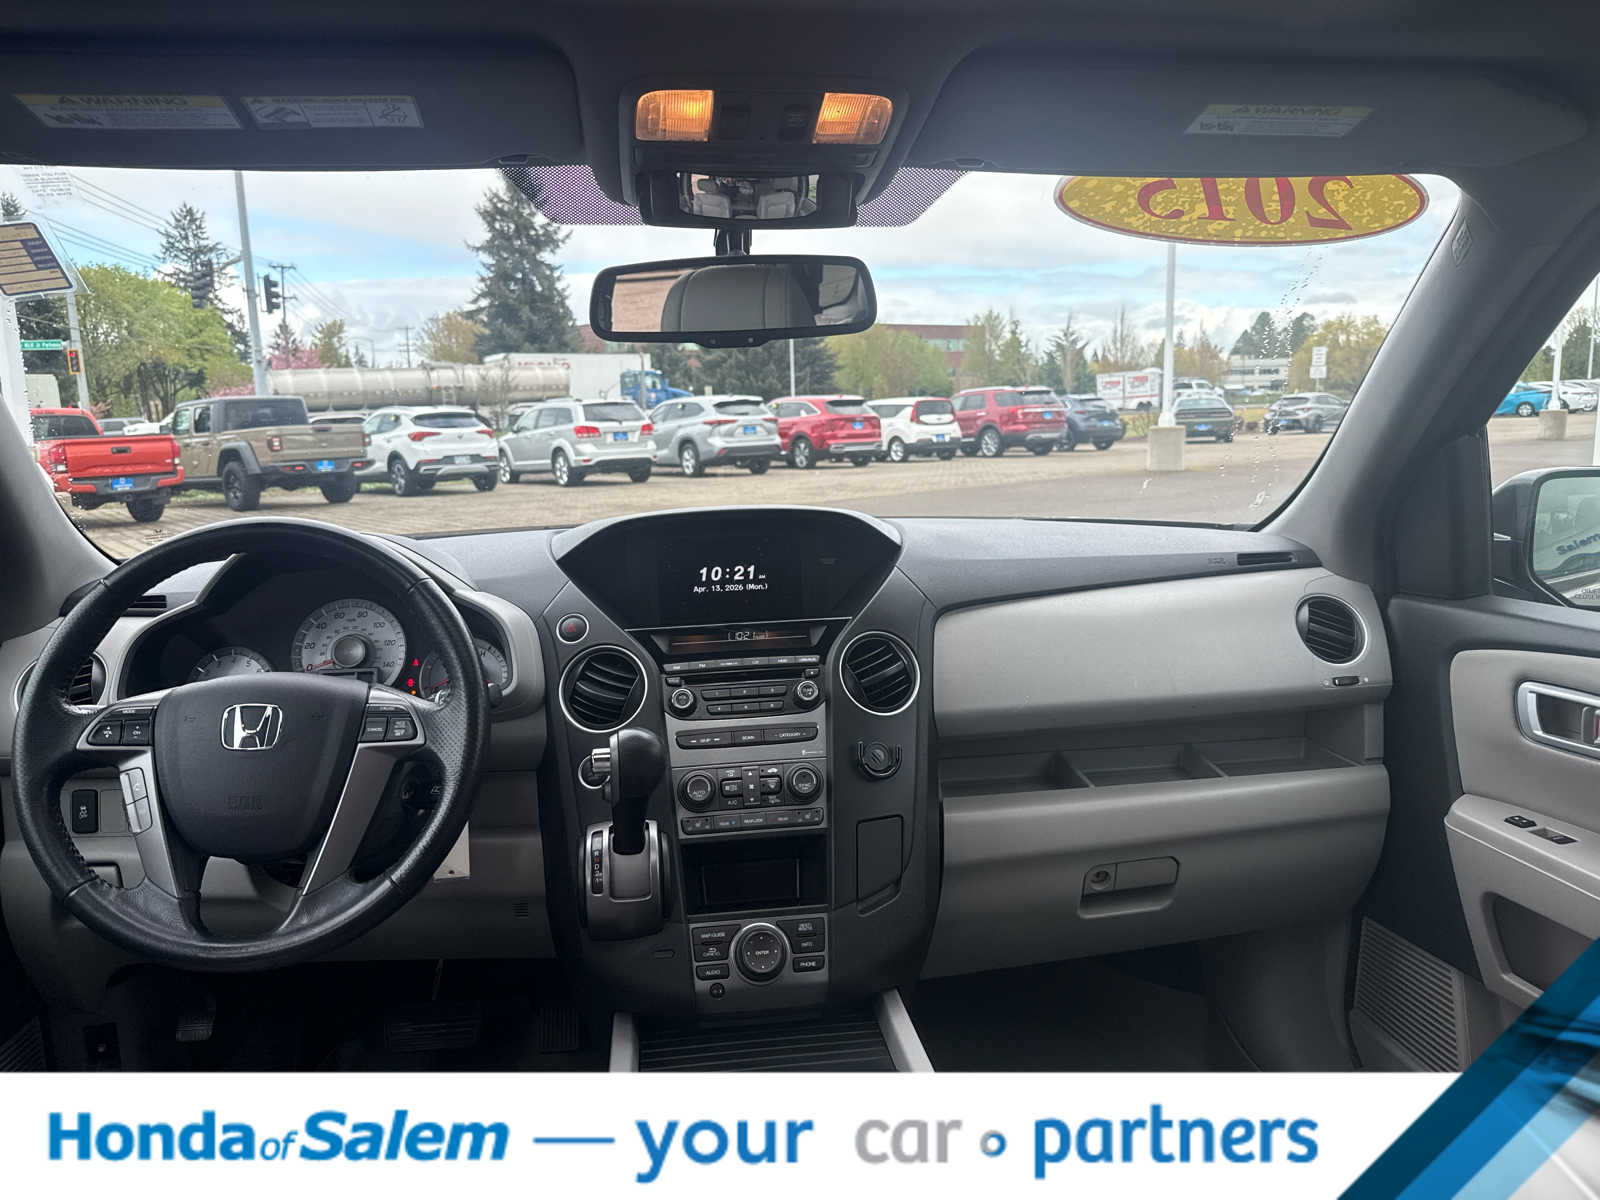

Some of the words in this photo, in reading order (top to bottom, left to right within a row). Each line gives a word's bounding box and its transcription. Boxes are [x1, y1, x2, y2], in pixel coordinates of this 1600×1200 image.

[699, 565, 755, 582] 10:21
[693, 586, 708, 594] Apr.
[725, 584, 744, 592] 2026
[334, 611, 345, 619] 60
[316, 622, 327, 630] 40
[373, 621, 386, 629] 100
[304, 642, 315, 650] 20
[384, 639, 396, 647] 120
